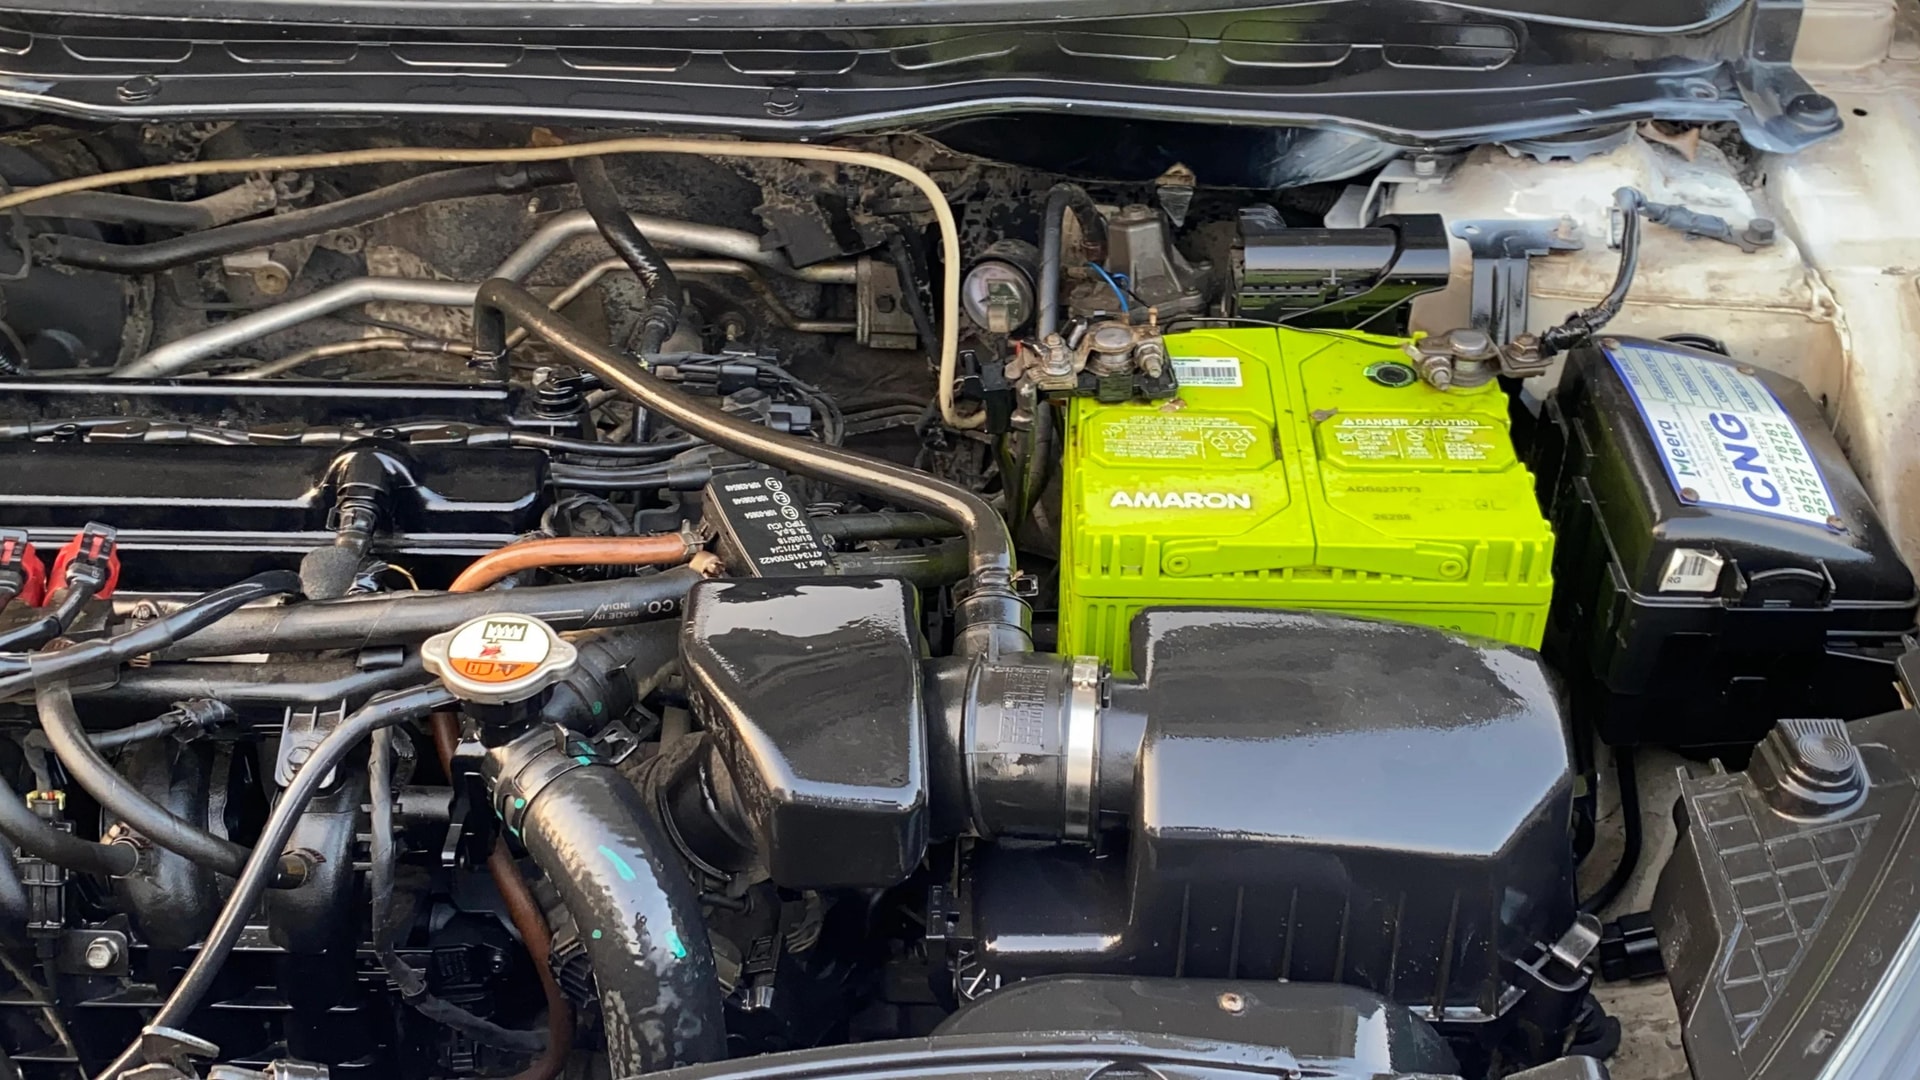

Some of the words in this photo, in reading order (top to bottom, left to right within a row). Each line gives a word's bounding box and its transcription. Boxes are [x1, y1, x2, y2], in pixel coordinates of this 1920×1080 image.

[1355, 418, 1409, 426] DANGER
[1422, 419, 1479, 427] CAUTION
[1700, 420, 1729, 463] APPROVED
[1745, 416, 1776, 465] RE-TESTING
[1762, 422, 1792, 462] 78781
[1656, 419, 1697, 477] Meera
[1709, 412, 1781, 507] CNG
[1776, 423, 1807, 464] 78782
[1110, 491, 1251, 509] AMARON
[1771, 467, 1800, 513] CYLINDER
[1785, 466, 1816, 514] 95127
[1800, 469, 1830, 517] 95127
[766, 522, 783, 530] ICU
[600, 602, 631, 612] INDIA
[608, 610, 640, 620] MADE
[643, 599, 674, 614] CO.
